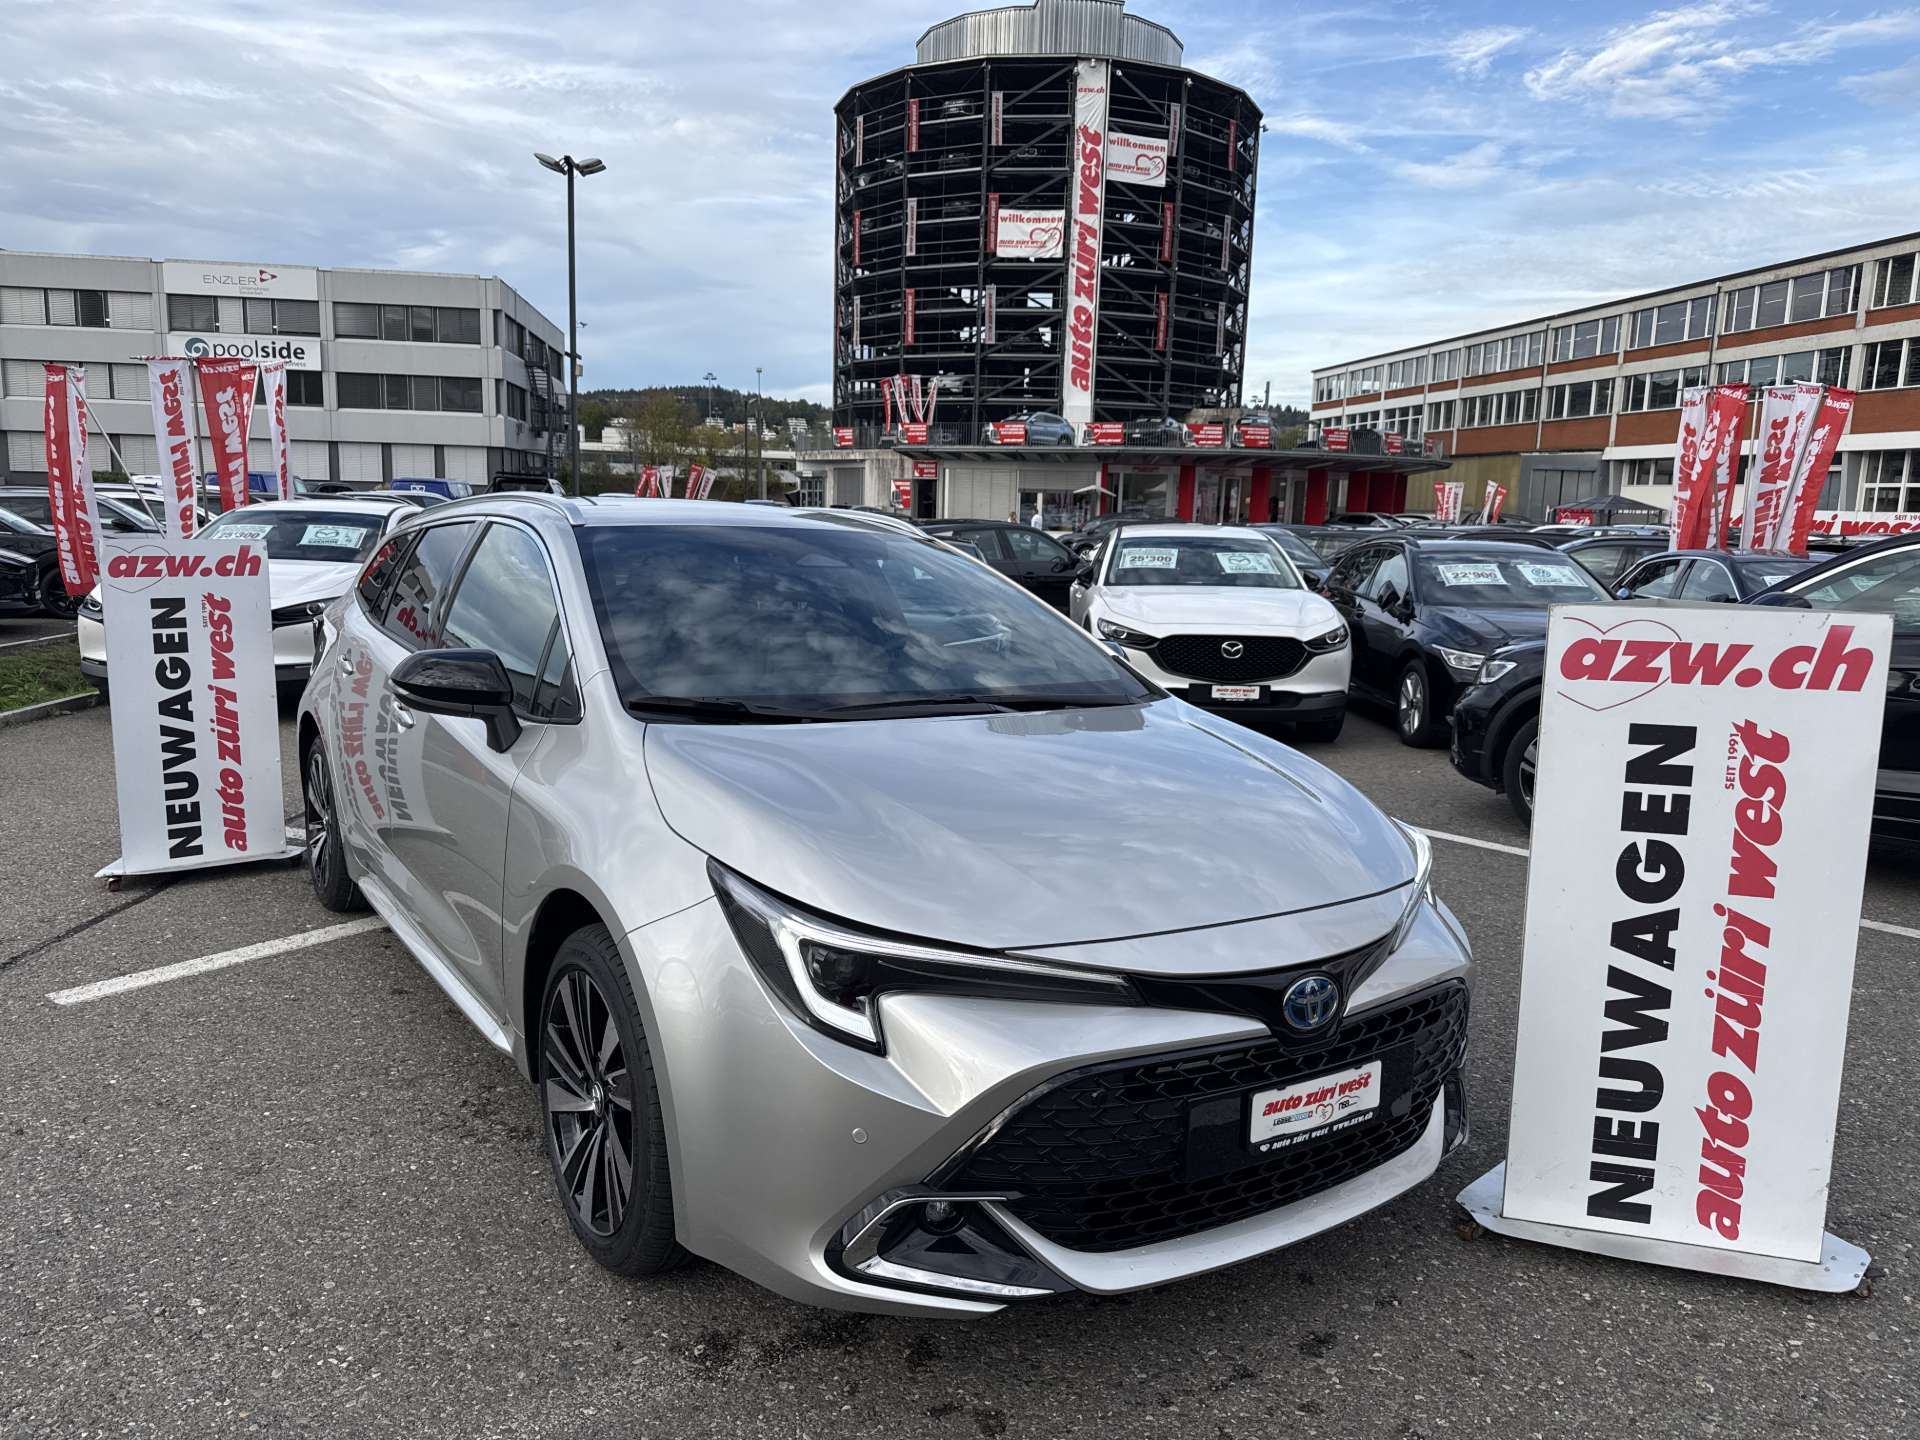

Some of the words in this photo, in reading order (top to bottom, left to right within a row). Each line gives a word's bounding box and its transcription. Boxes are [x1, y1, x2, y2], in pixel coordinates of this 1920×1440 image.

[1078, 86, 1105, 94] azw.ch
[1079, 124, 1102, 215] west
[1108, 137, 1166, 152] willkommen
[1000, 214, 1062, 224] willkommen
[203, 274, 257, 286] ENZLER
[1073, 219, 1098, 304] züri
[213, 340, 305, 360] poolside
[1070, 305, 1093, 392] auto
[108, 545, 262, 577] azw.ch
[201, 592, 236, 679] west
[1560, 625, 1874, 692] azw.ch
[150, 597, 204, 859] NEUWAGEN
[207, 684, 242, 766] züri
[1728, 733, 1740, 761] 1991
[215, 767, 248, 852] auto
[1725, 766, 1736, 790] SEIT
[1728, 719, 1790, 899] west
[1586, 722, 1698, 1224] NEUWAGEN
[1704, 903, 1772, 1074] züri
[1263, 1093, 1302, 1117] auto
[1303, 1082, 1338, 1107] züri
[1338, 1072, 1372, 1096] west
[1271, 1139, 1290, 1150] auto
[1292, 1132, 1310, 1144] züri
[1311, 1127, 1330, 1139] west
[1332, 1111, 1374, 1132] www.azw.ch
[1693, 1071, 1757, 1242] auto
